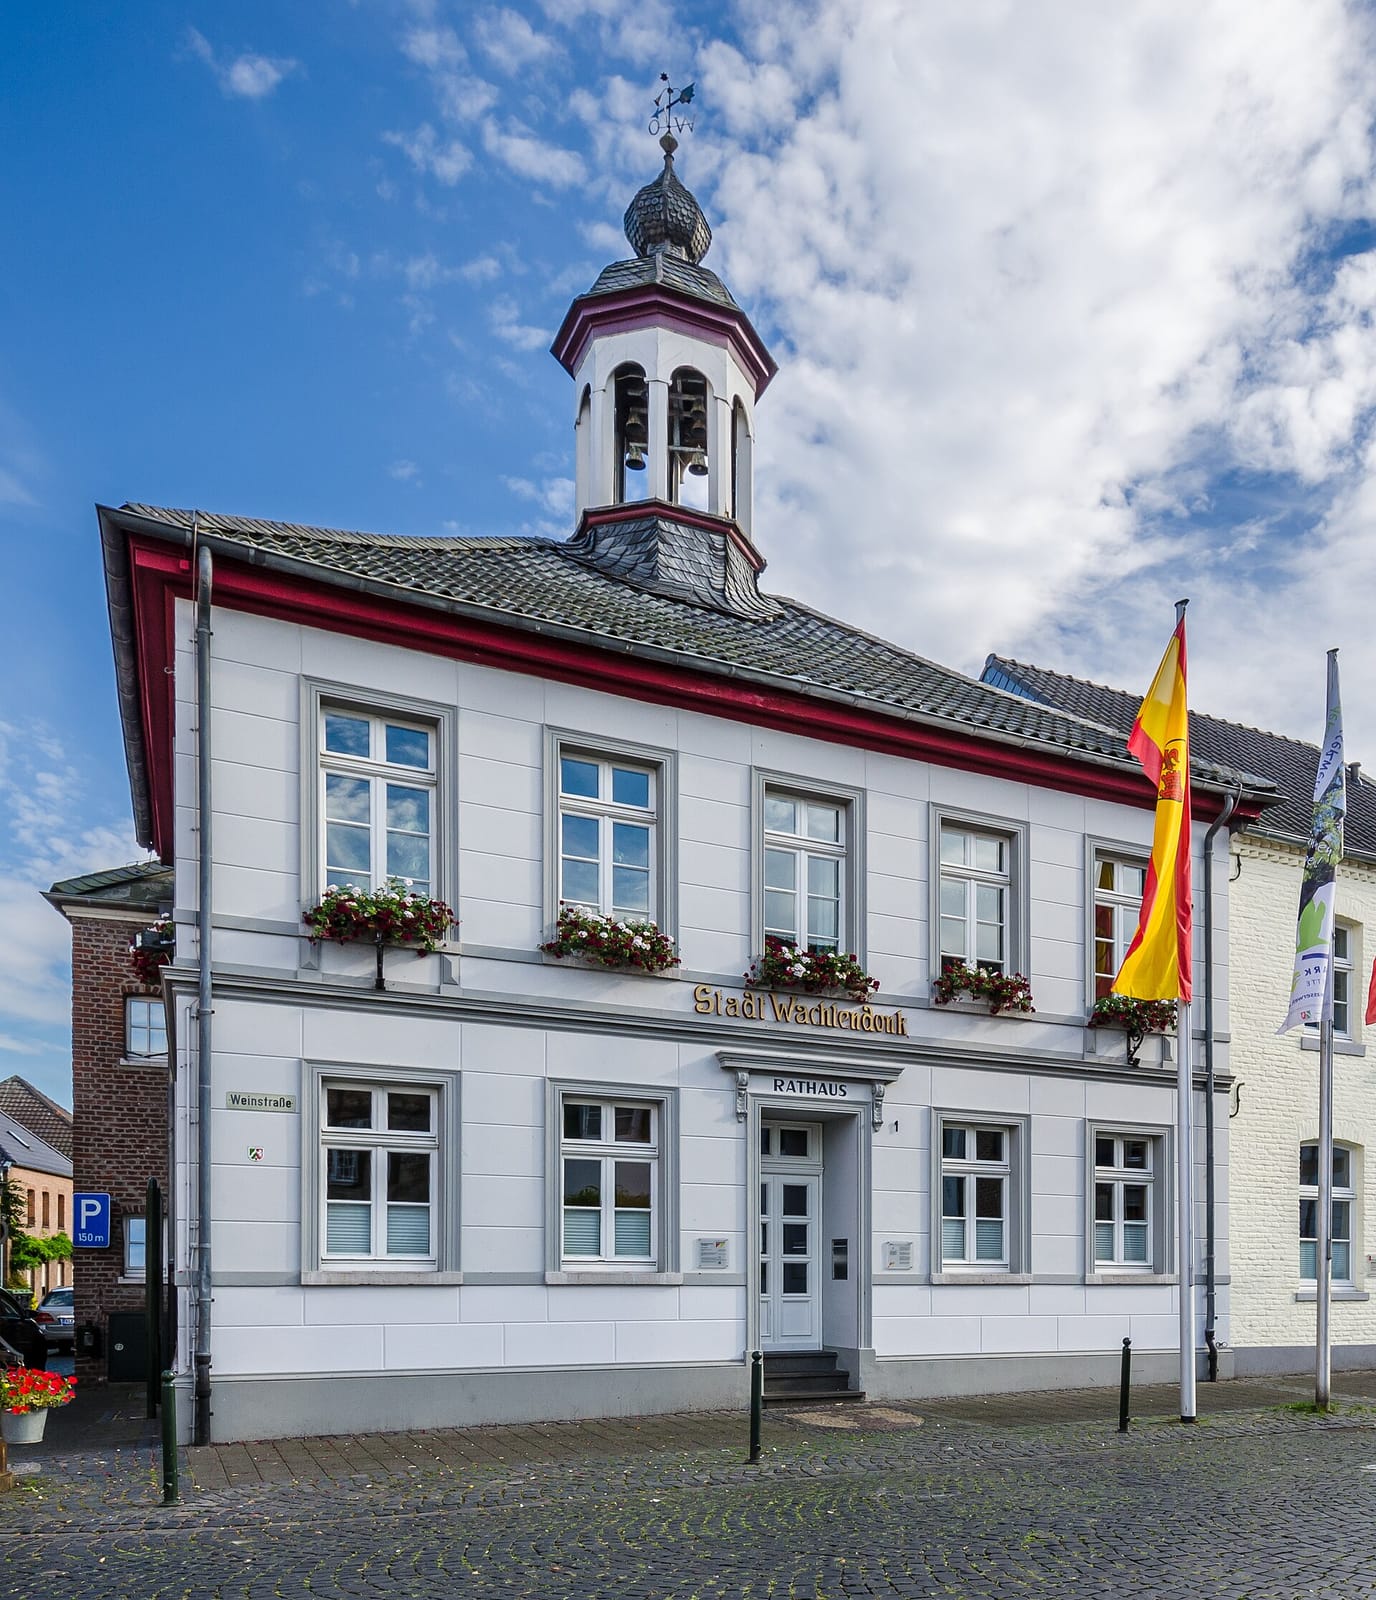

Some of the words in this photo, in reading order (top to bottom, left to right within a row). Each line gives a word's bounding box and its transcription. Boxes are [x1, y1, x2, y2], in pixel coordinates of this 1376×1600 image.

[694, 984, 767, 1020] Stadt
[768, 993, 909, 1037] Wachtendonk
[773, 1078, 848, 1097] RATHAUS
[230, 1094, 292, 1108] Weinstraße
[893, 1120, 899, 1132] 1
[80, 1199, 102, 1229] P
[78, 1232, 94, 1242] 150
